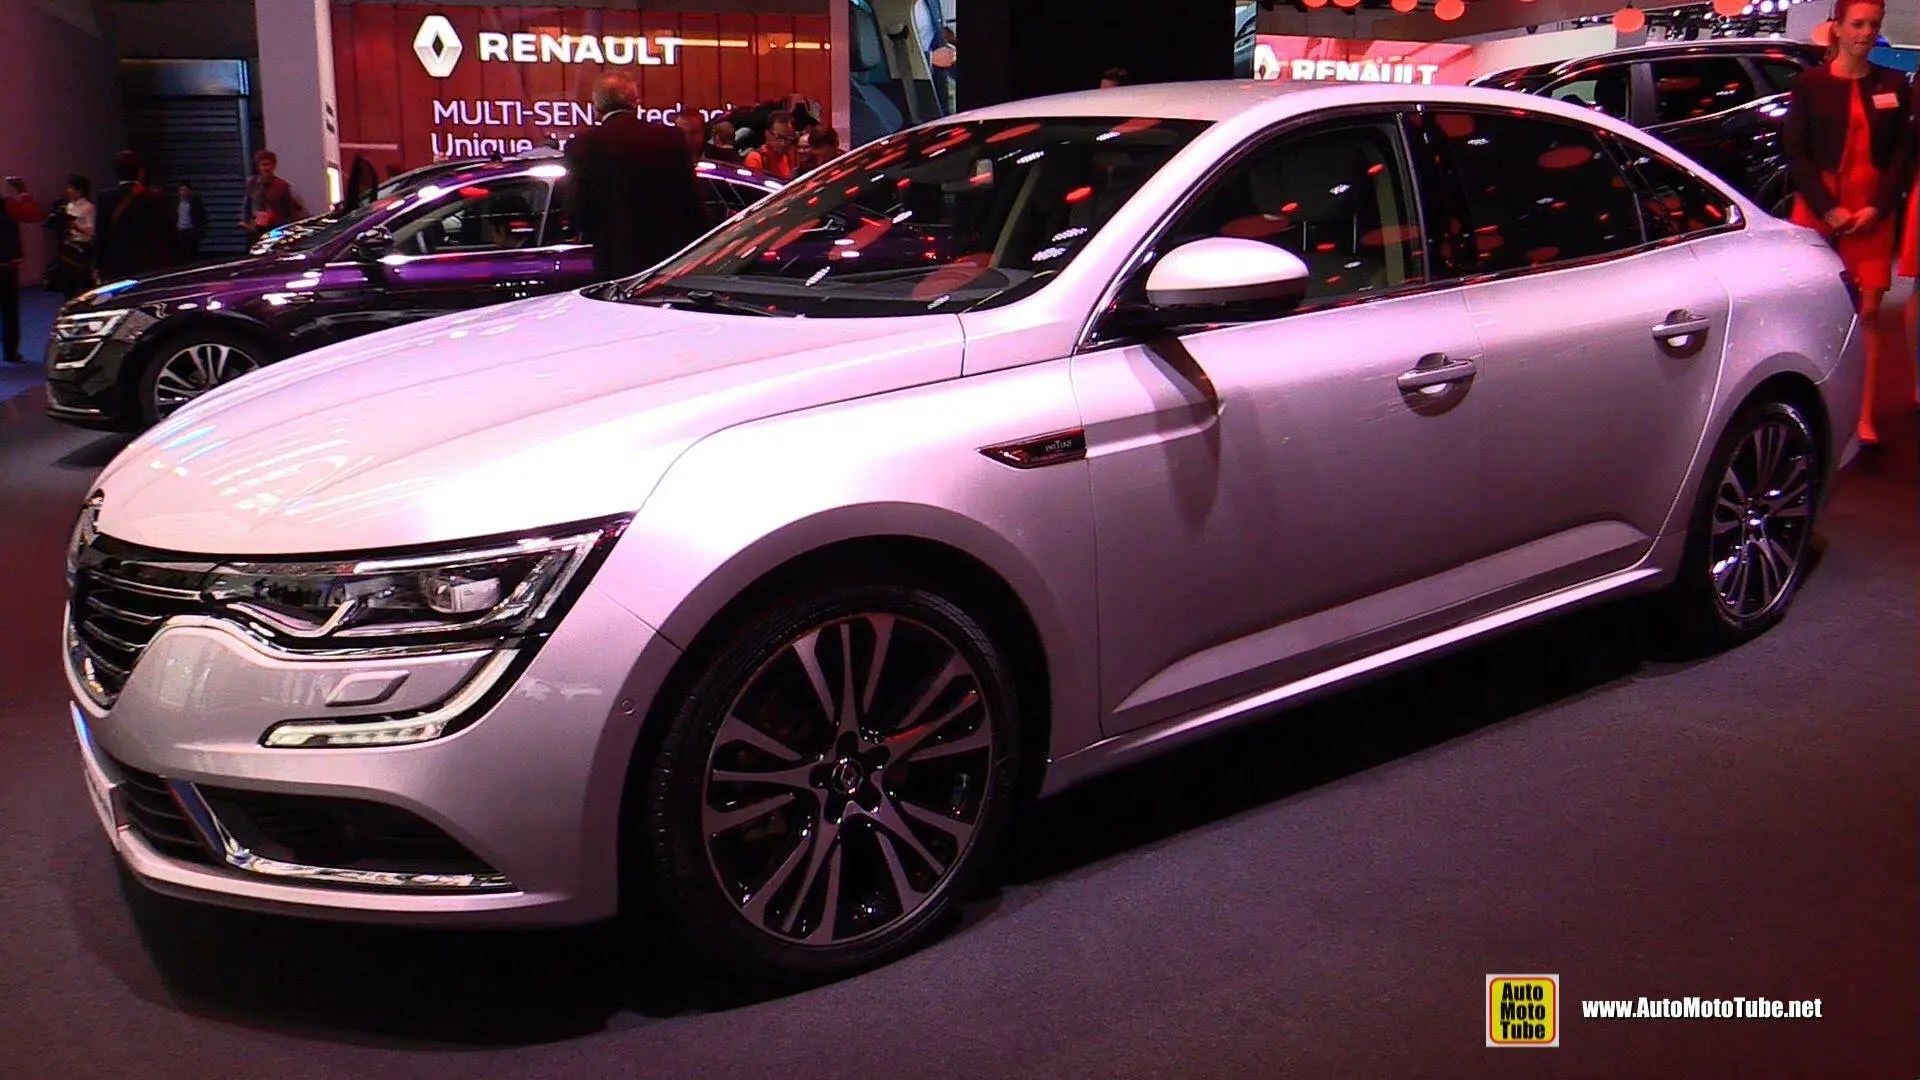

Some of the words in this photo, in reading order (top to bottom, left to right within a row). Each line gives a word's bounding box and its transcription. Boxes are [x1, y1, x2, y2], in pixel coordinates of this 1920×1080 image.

[478, 32, 681, 65] RENAULT
[1292, 59, 1438, 85] RENAULT
[433, 100, 602, 126] MULTI-SEN
